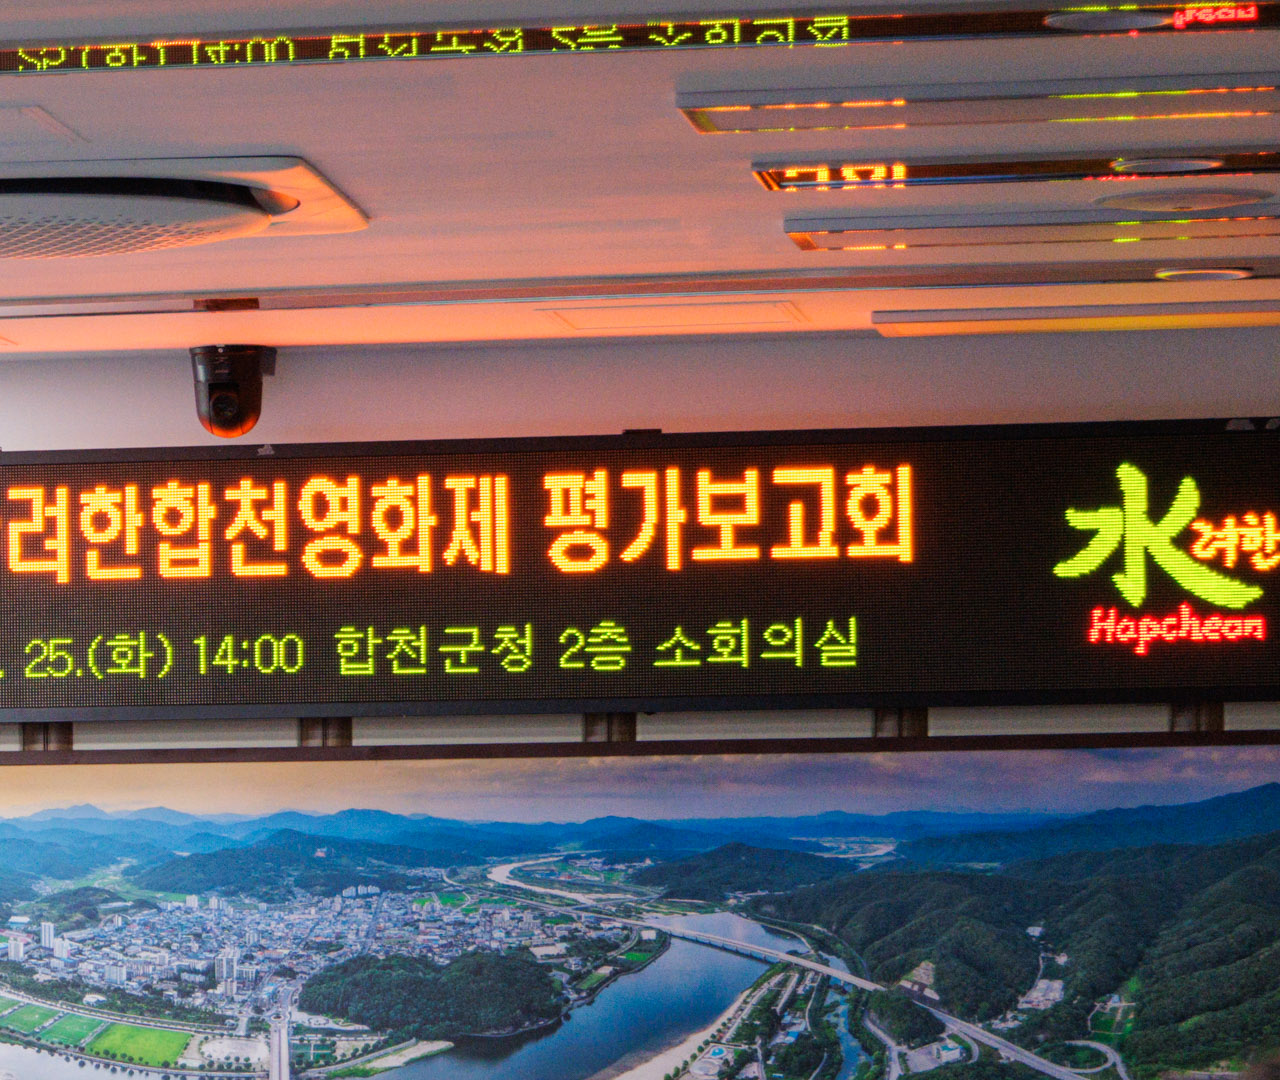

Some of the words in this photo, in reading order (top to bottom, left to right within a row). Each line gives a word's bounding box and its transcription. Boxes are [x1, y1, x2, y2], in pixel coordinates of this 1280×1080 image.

[543, 463, 914, 573] 평가보고회
[24, 631, 173, 680] 25.(화)
[193, 634, 304, 675] 14:00
[334, 623, 532, 675] 합천군청
[559, 621, 632, 671] 2층
[653, 617, 857, 668] 소회의실
[1087, 601, 1267, 656] Hapcheon
